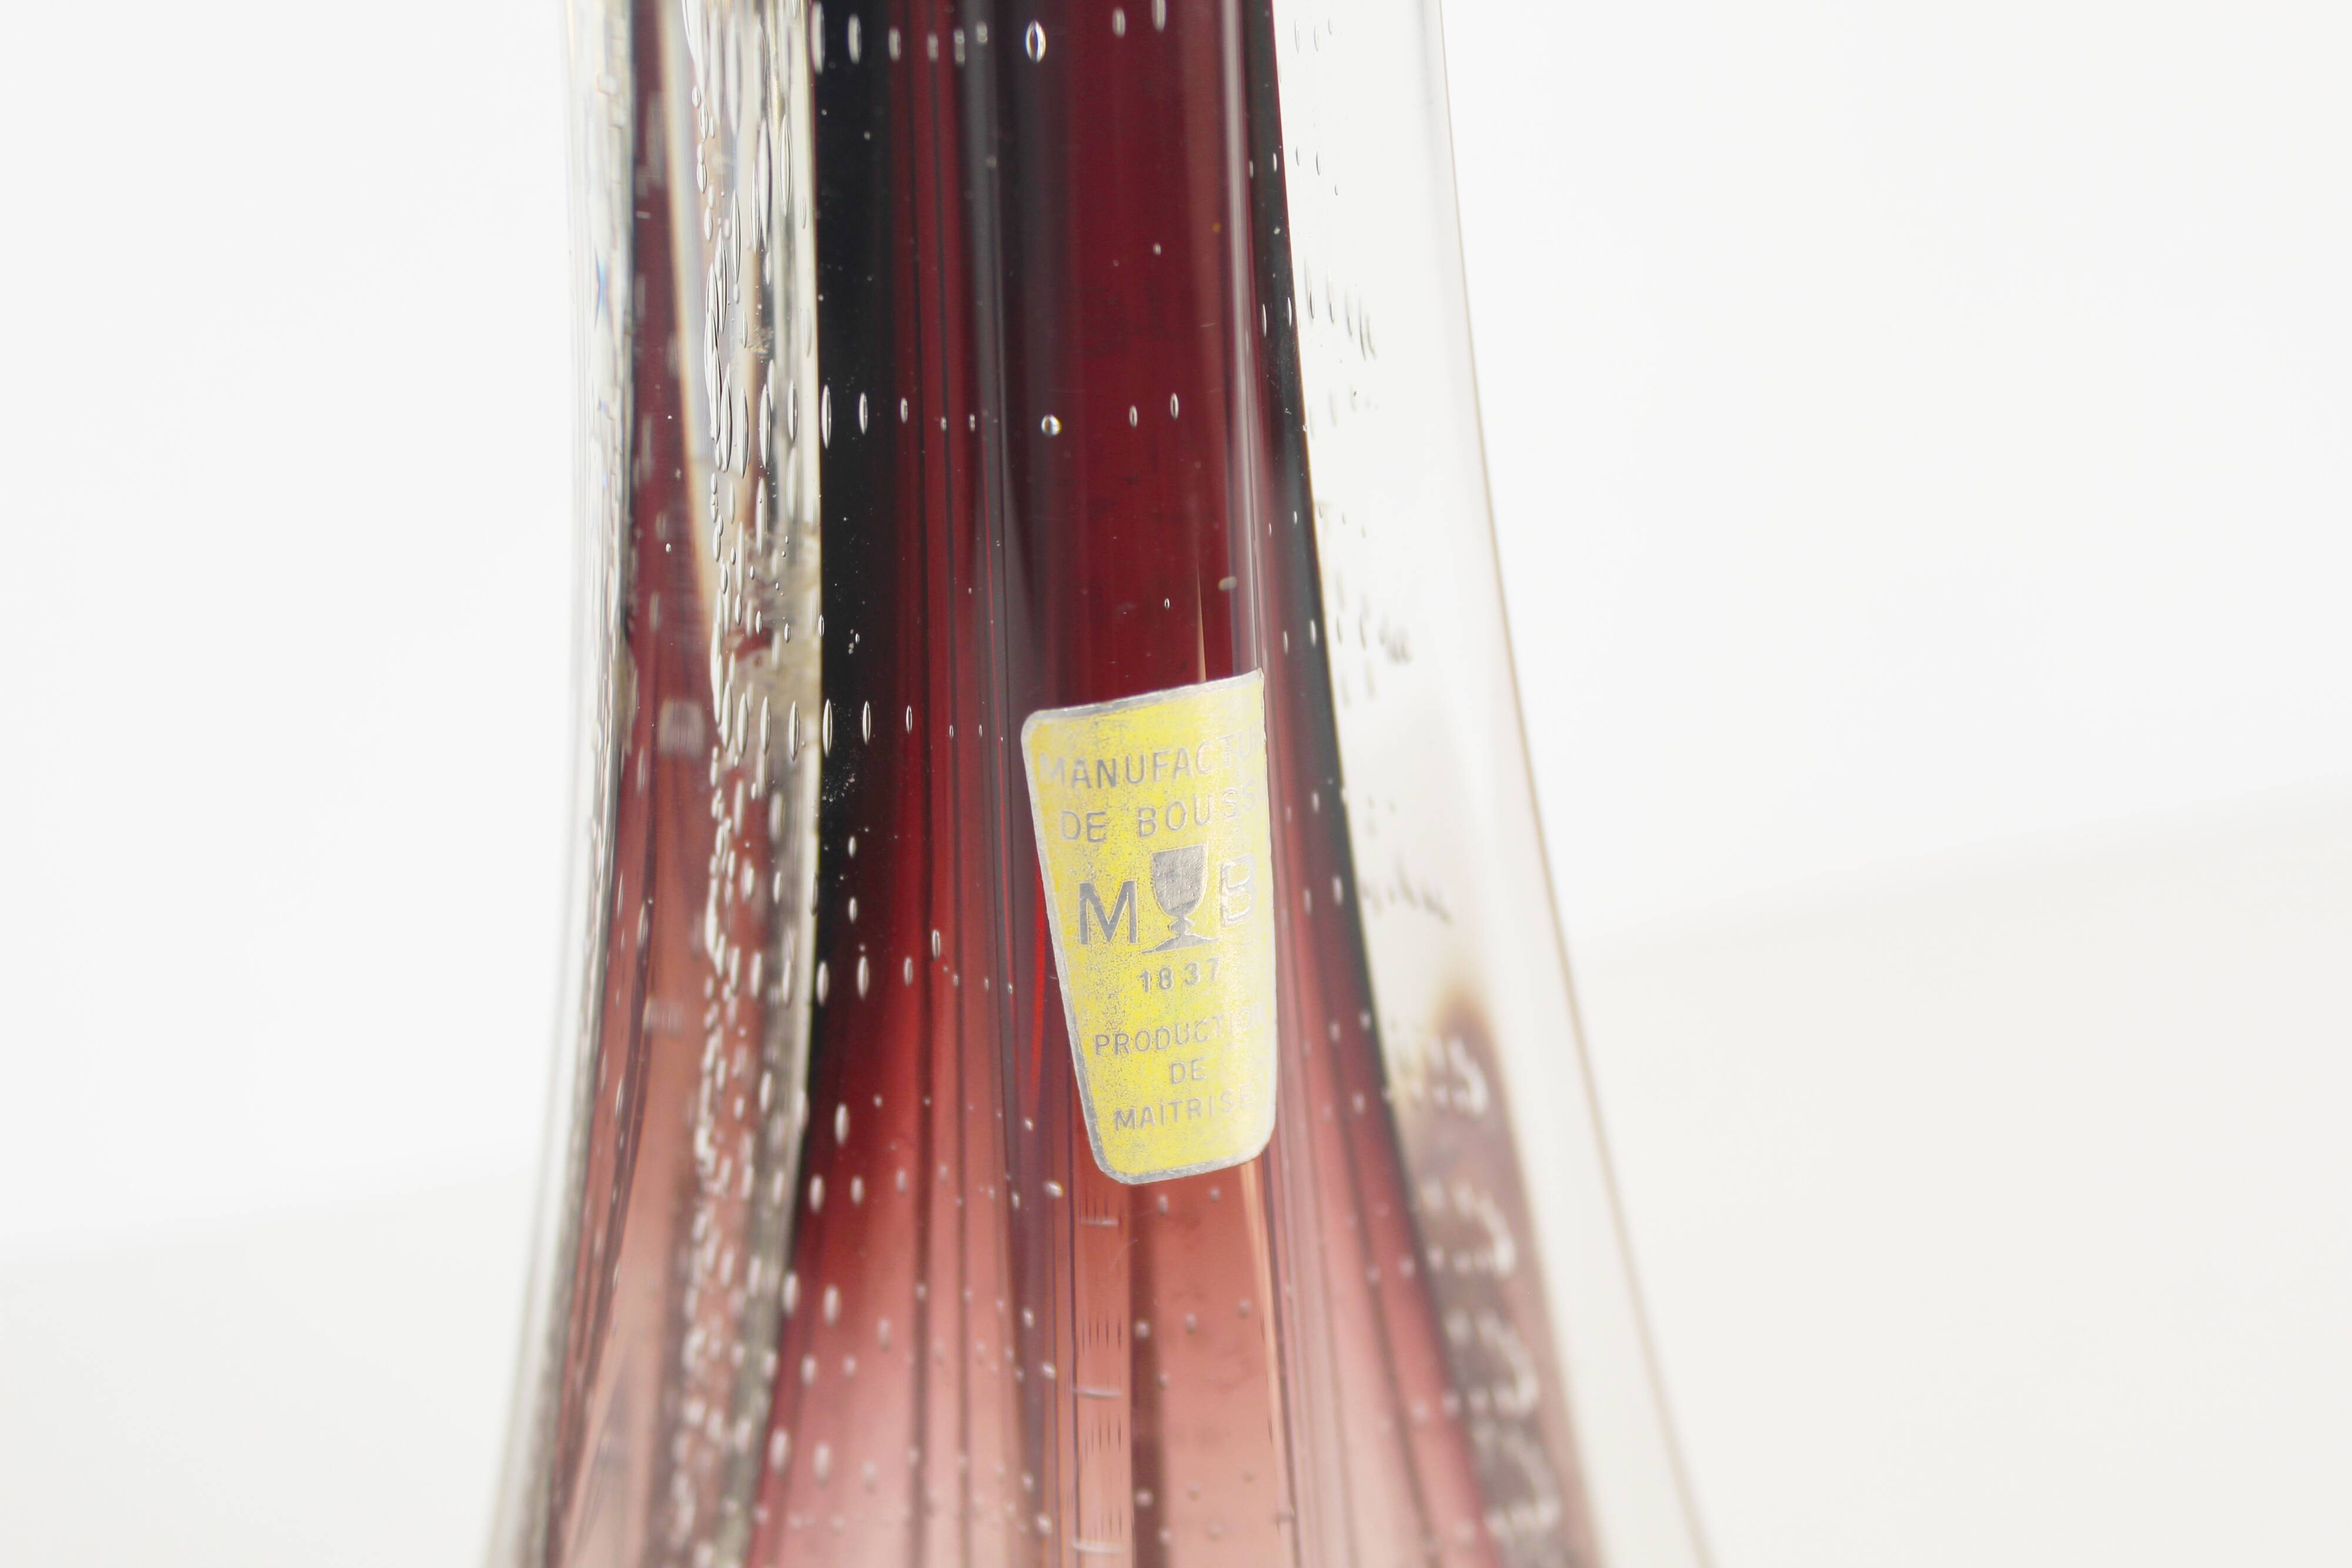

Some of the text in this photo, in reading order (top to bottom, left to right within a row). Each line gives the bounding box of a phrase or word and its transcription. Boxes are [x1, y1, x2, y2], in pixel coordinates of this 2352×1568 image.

[1040, 727, 1257, 789] MANUFACTU
[1061, 780, 1258, 842] DE BOUSS
[1078, 853, 1257, 945] M B
[1138, 957, 1222, 993] 1837
[1094, 1005, 1256, 1057] PRODUCTIO
[1170, 1057, 1207, 1085] DE
